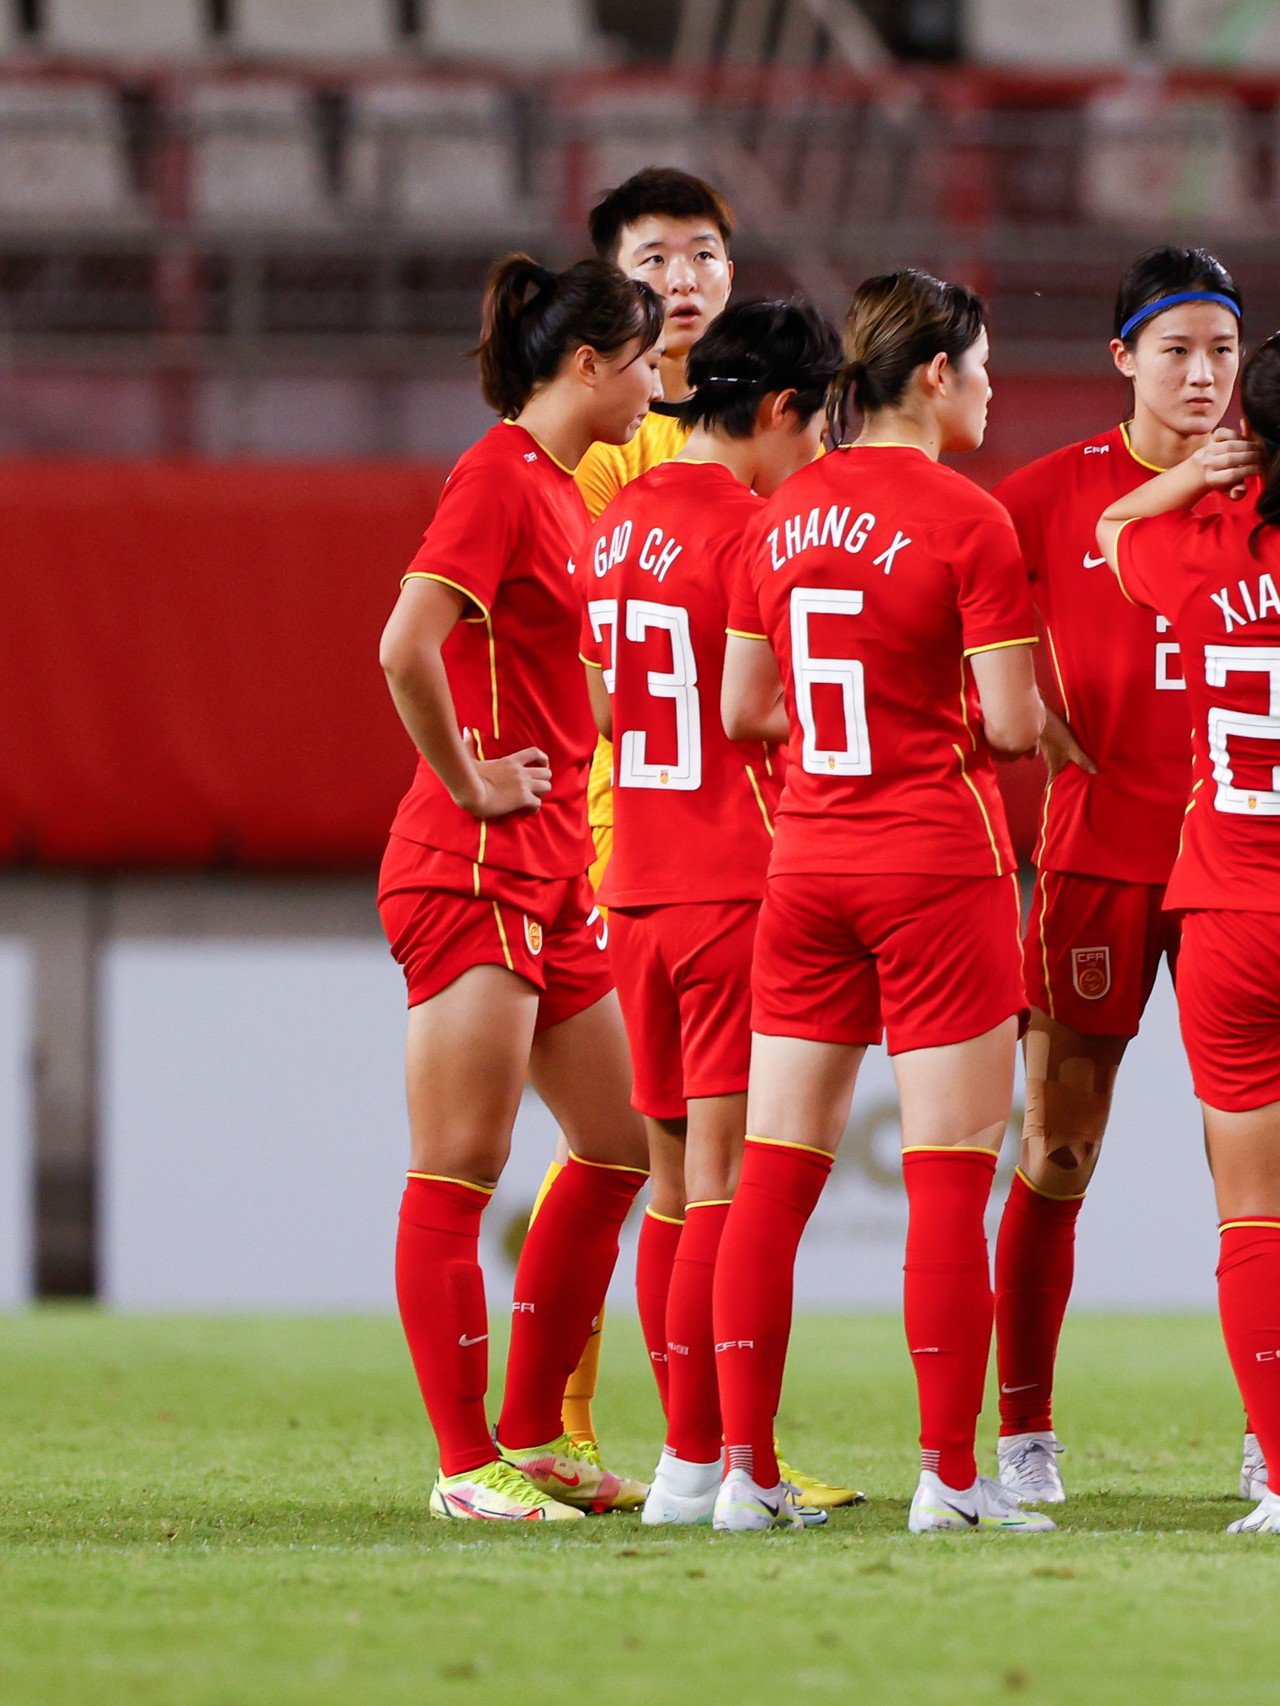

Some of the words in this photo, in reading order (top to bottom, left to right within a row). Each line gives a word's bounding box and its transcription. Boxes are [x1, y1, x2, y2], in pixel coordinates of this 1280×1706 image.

[593, 519, 633, 578] GAO
[639, 527, 683, 583] CH
[766, 504, 875, 572] ZHANG
[872, 530, 912, 575] X
[789, 586, 872, 776] 6
